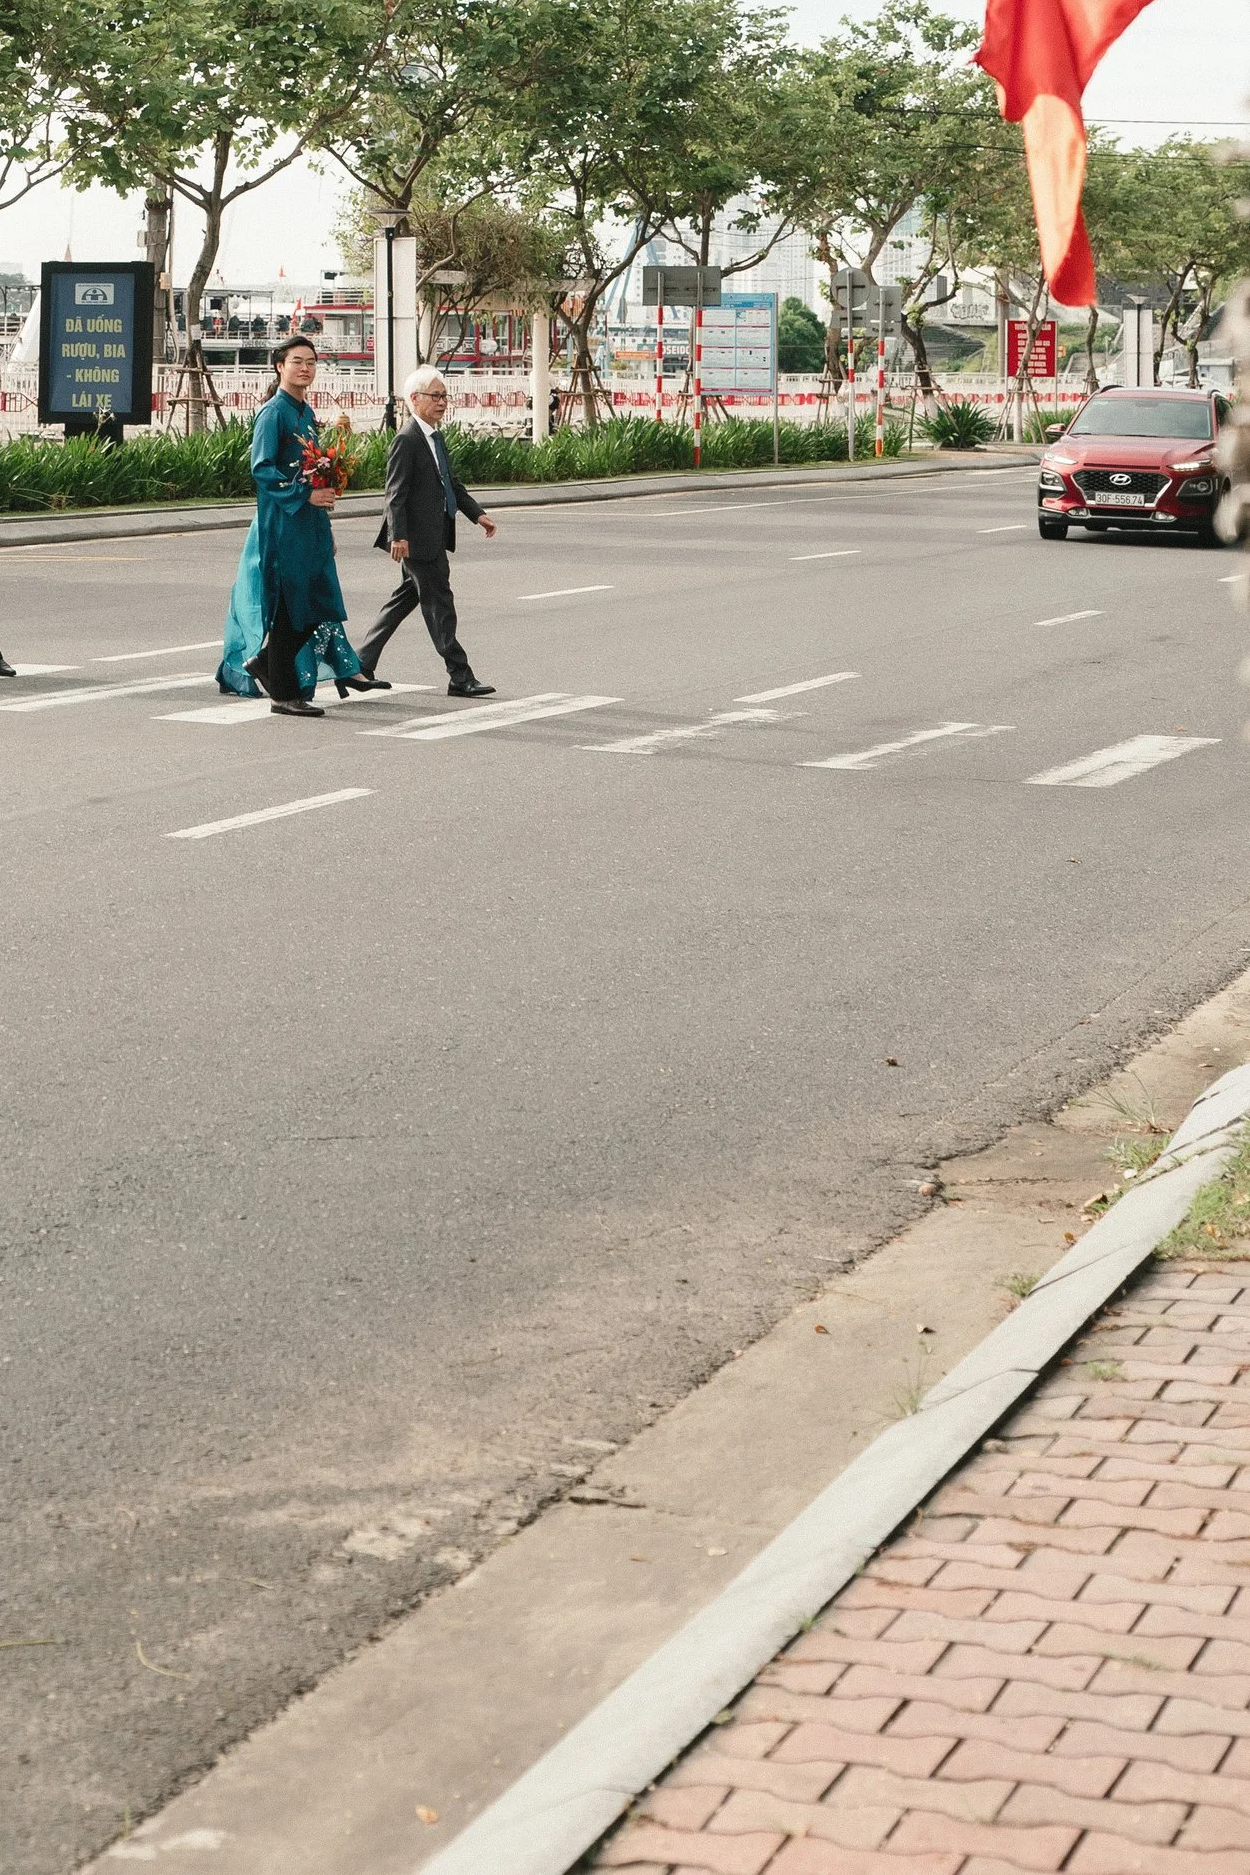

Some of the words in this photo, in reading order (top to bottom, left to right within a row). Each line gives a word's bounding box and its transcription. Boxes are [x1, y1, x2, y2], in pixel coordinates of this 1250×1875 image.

[65, 315, 83, 333] ĐÃ
[86, 313, 123, 333] UỐNG
[61, 342, 100, 361] RƯỢU,
[103, 344, 126, 358] BIA
[75, 366, 120, 383] KHÔNG
[71, 391, 92, 408] LÁI
[96, 394, 113, 408] XE
